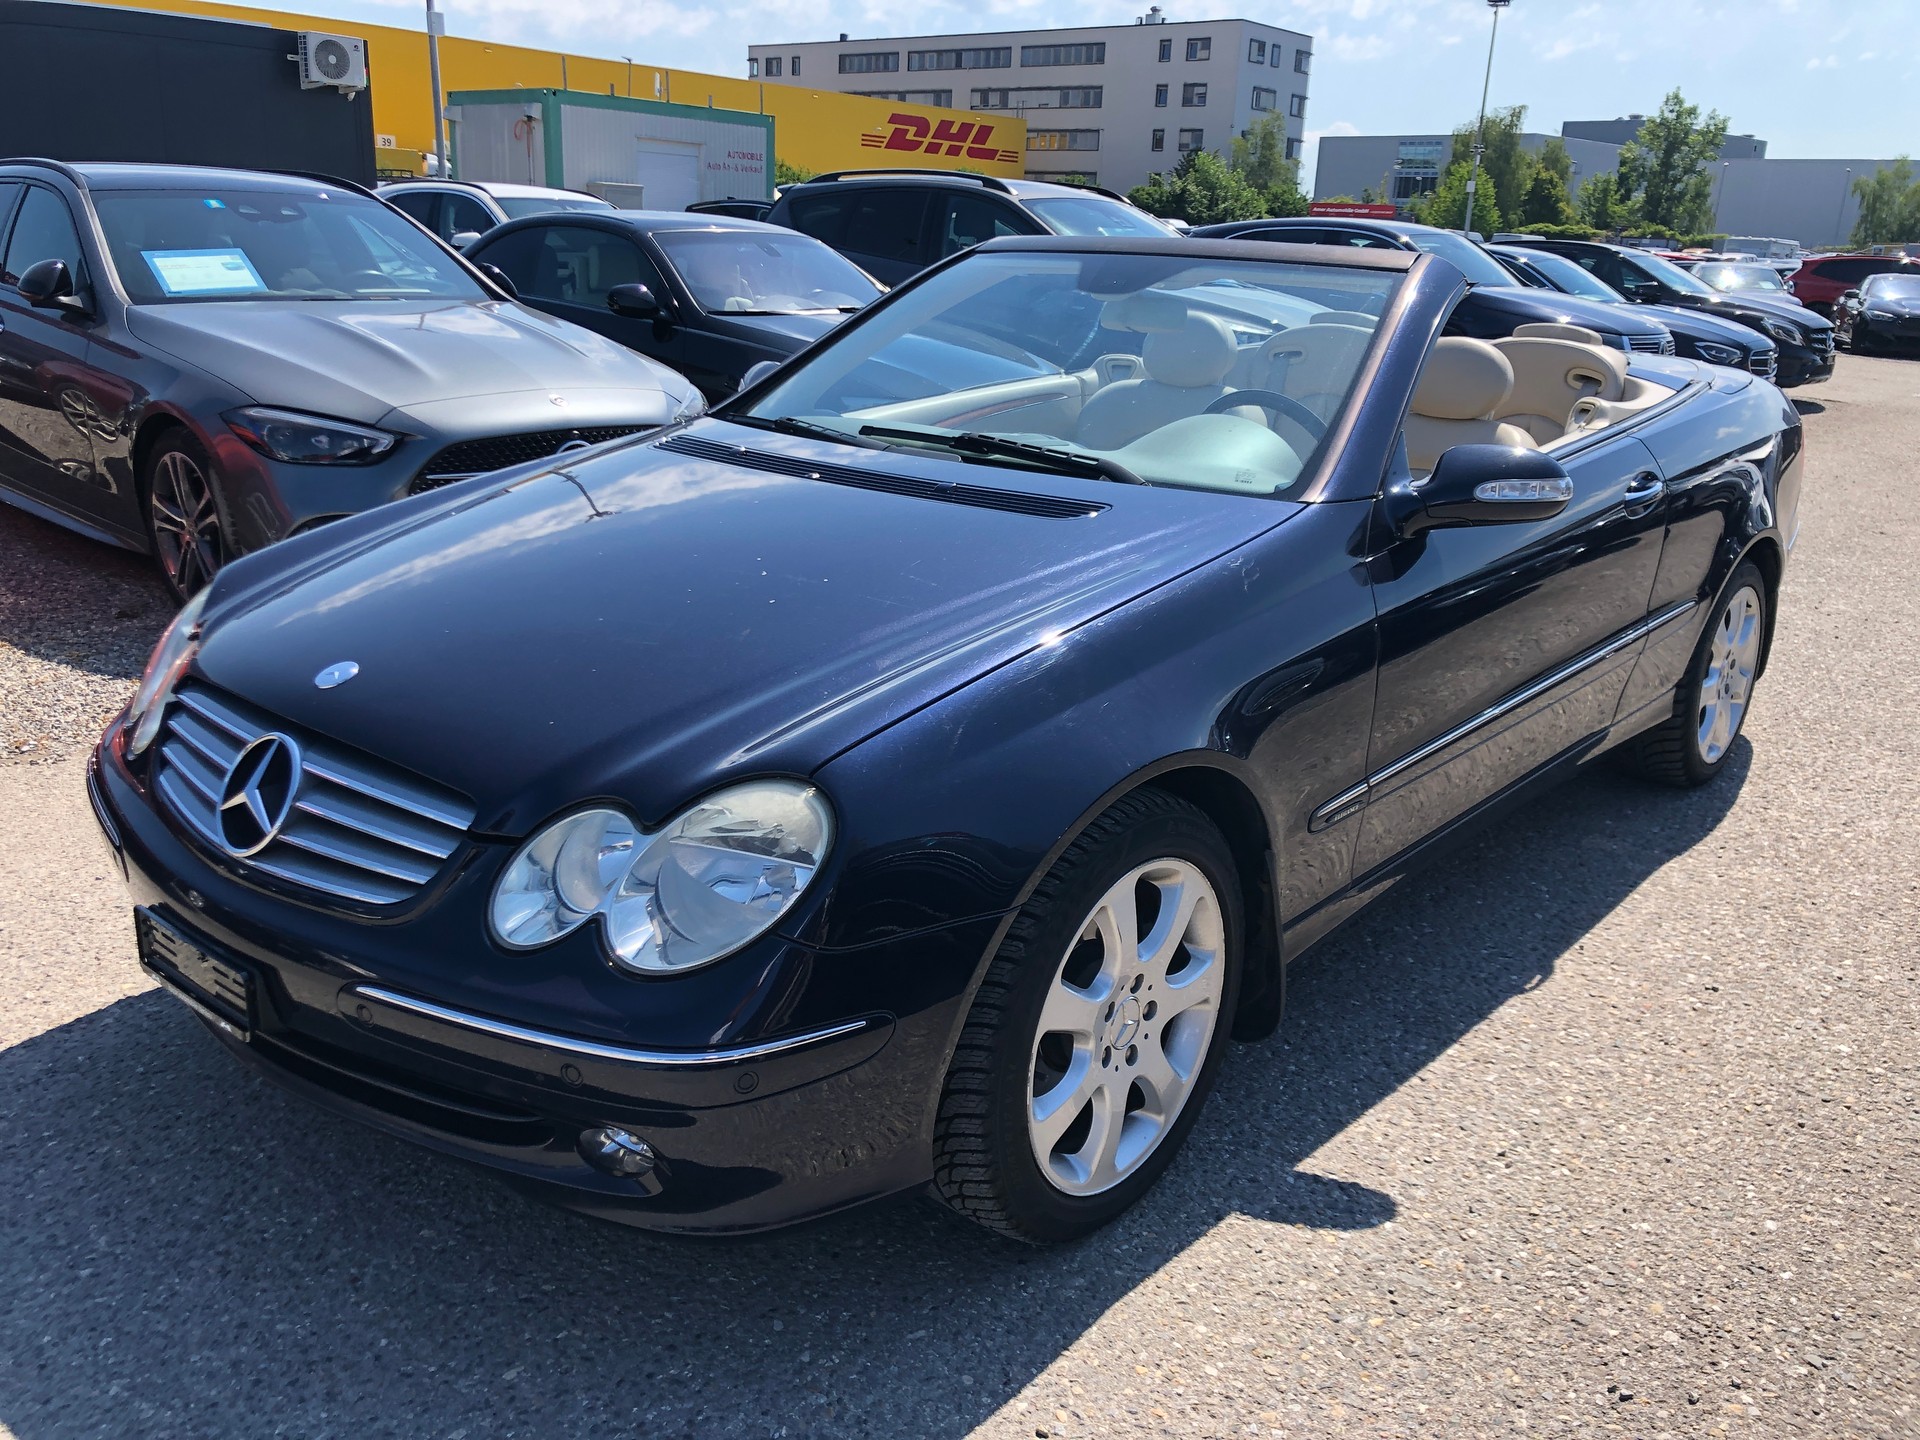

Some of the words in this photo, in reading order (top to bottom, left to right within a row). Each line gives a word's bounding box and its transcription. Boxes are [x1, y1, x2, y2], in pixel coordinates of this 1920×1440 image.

[381, 137, 392, 147] 39
[884, 113, 999, 161] DHL
[727, 150, 764, 161] AUTOMOBILE
[707, 162, 721, 171] Auto
[740, 164, 763, 174] Verkauf
